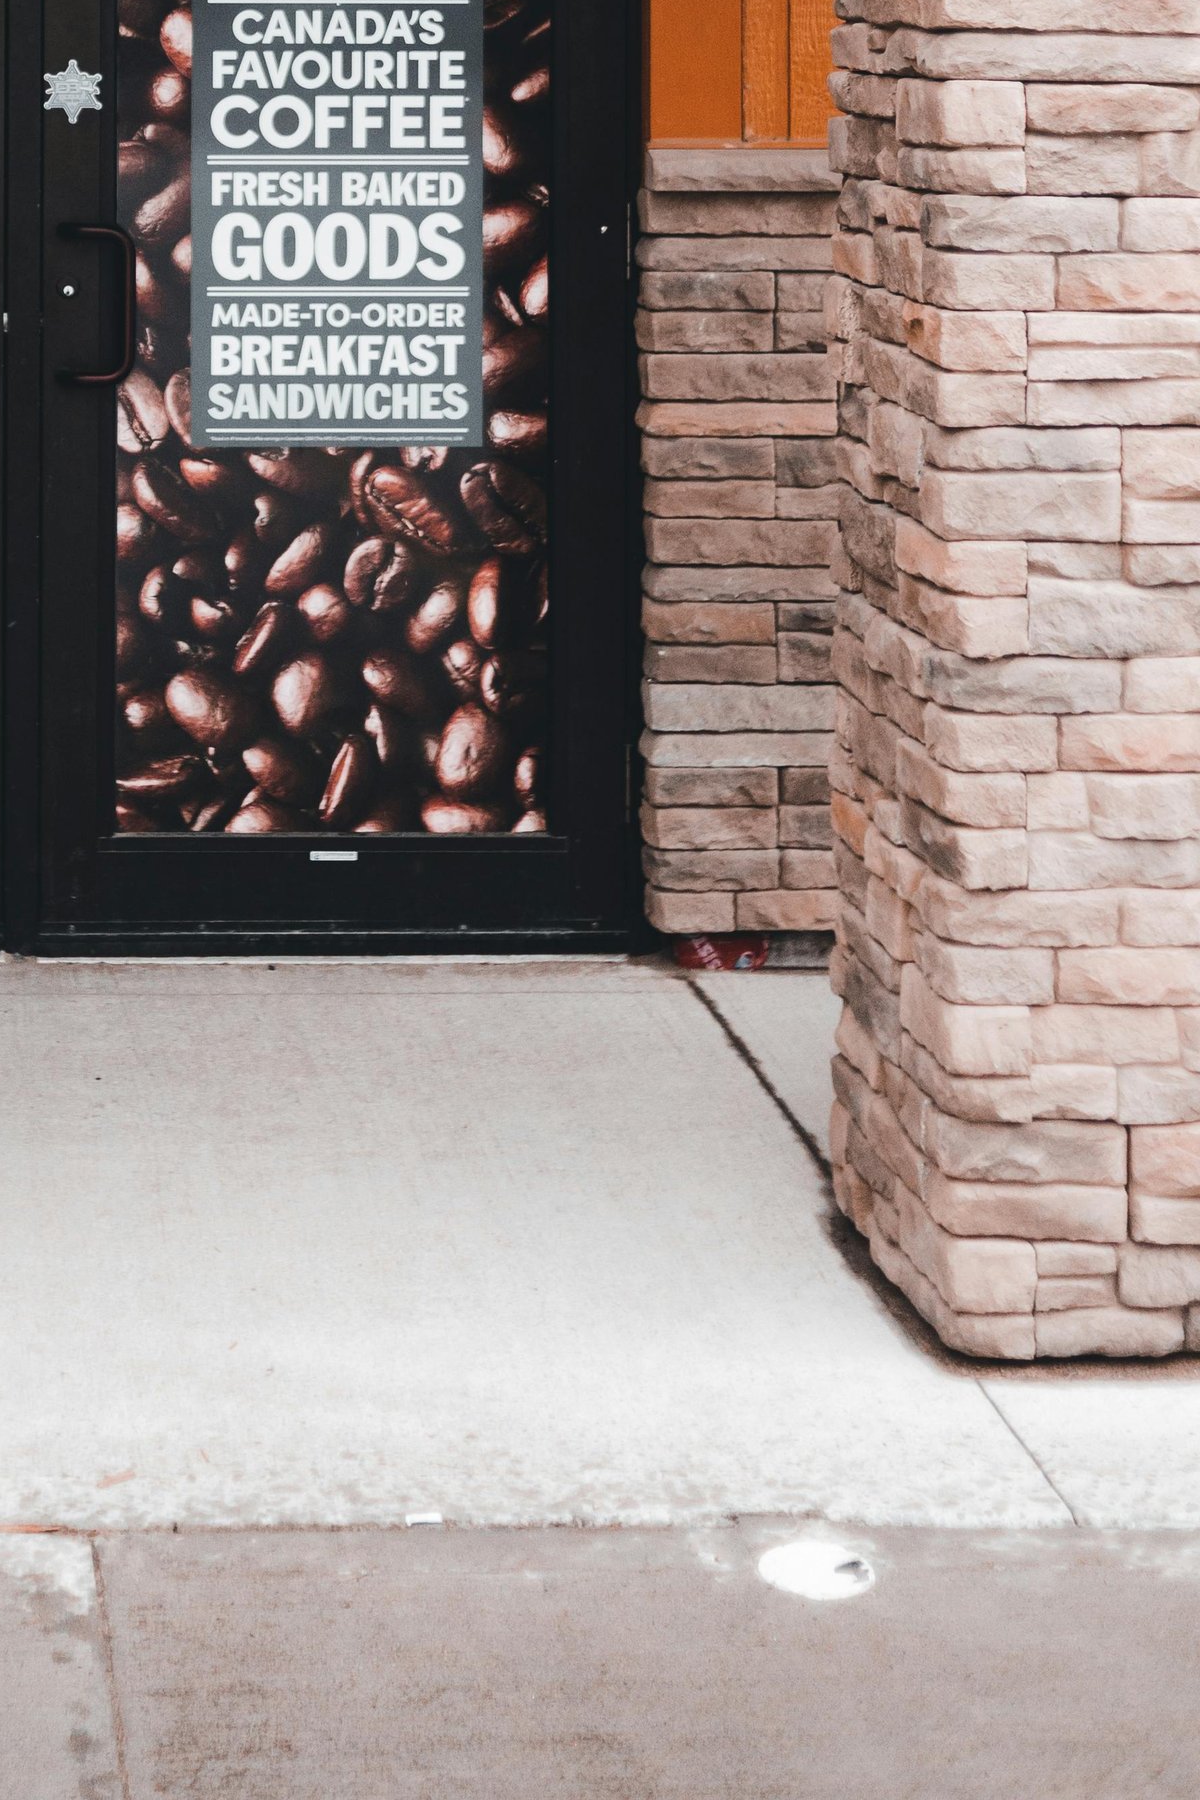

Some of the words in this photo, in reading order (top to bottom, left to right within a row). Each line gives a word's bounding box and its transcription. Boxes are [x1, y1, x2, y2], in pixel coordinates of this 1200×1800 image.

[232, 10, 445, 45] CANADA'S
[212, 50, 466, 90] FAVOURITE
[211, 171, 329, 207] FRESH
[341, 171, 467, 207] BAKED
[211, 212, 467, 282] GOODS
[211, 303, 466, 328] MADE-TO-ORDER
[210, 334, 466, 377] BREAKFAST
[207, 382, 470, 421] SANDWICHES
